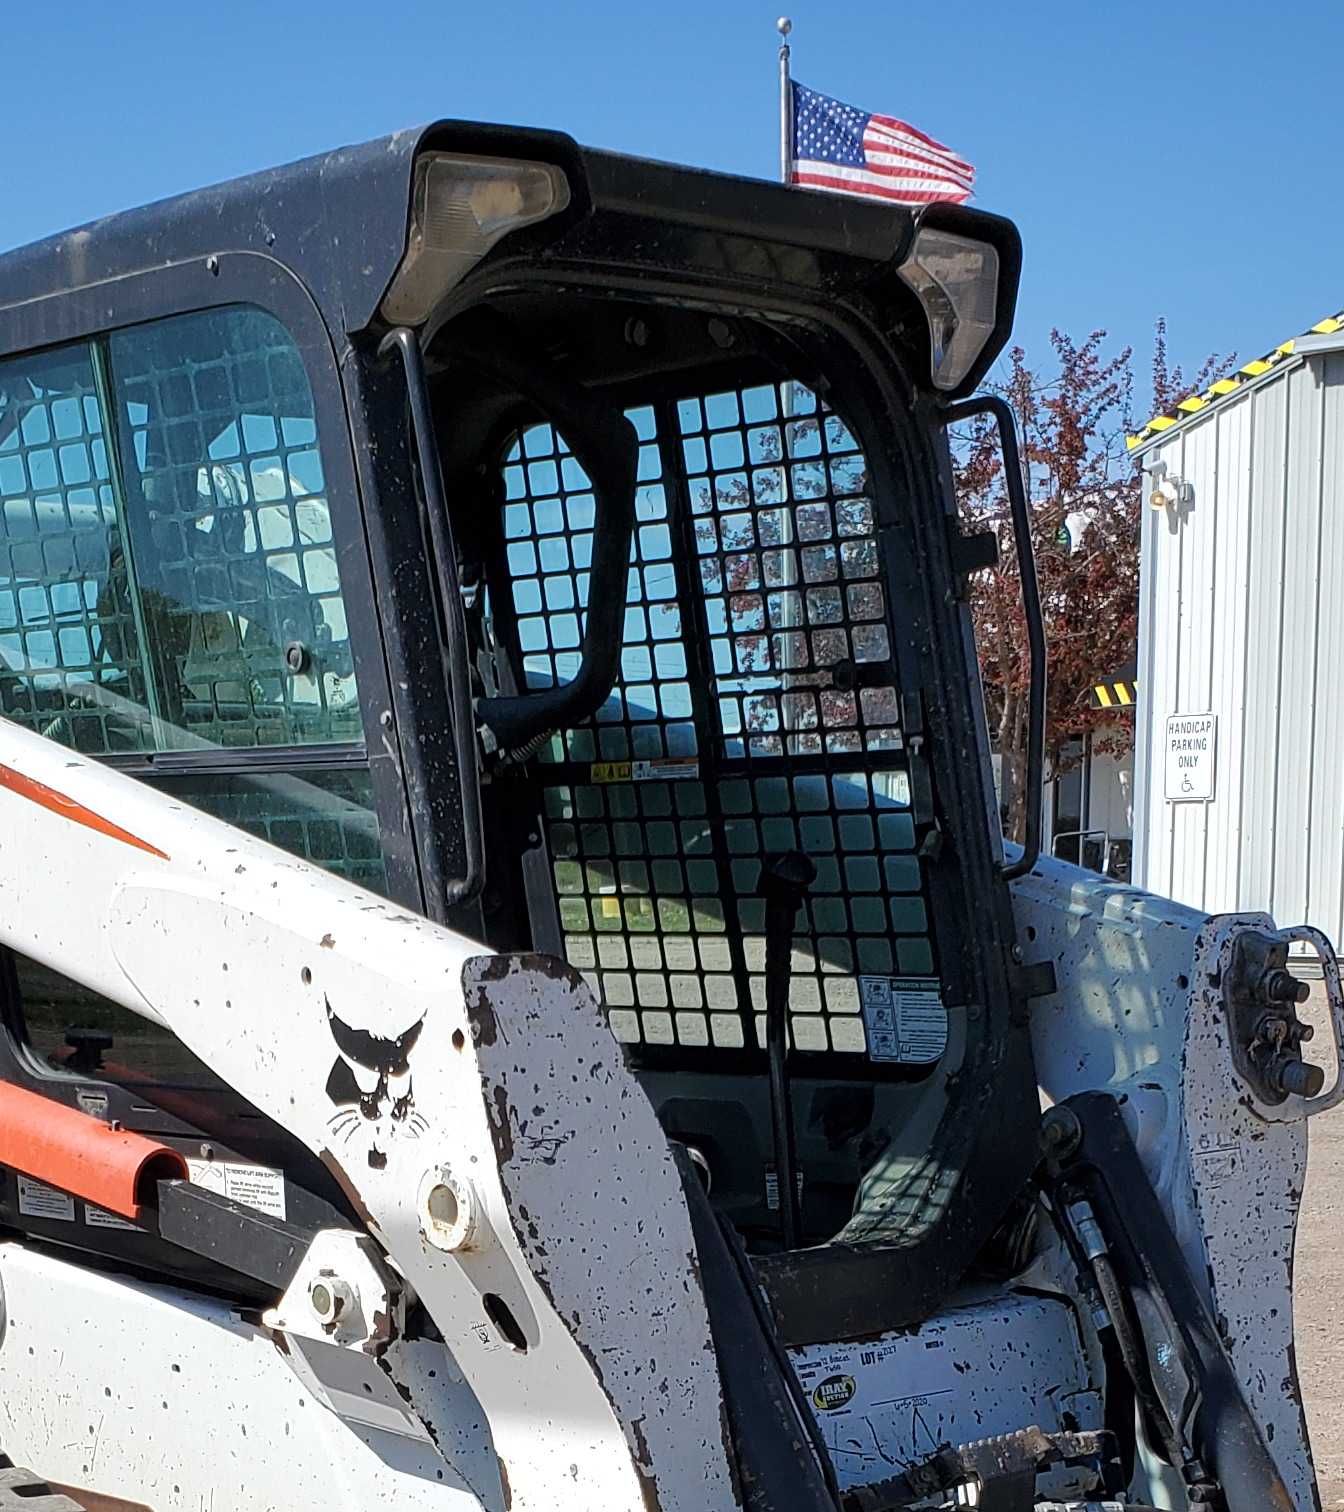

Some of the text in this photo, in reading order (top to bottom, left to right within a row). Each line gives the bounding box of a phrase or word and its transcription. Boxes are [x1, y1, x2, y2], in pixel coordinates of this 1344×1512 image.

[1169, 721, 1212, 734] HANDICAP
[1171, 738, 1207, 751] PARKING
[1178, 756, 1199, 768] ONLY
[860, 1351, 875, 1366] LOT
